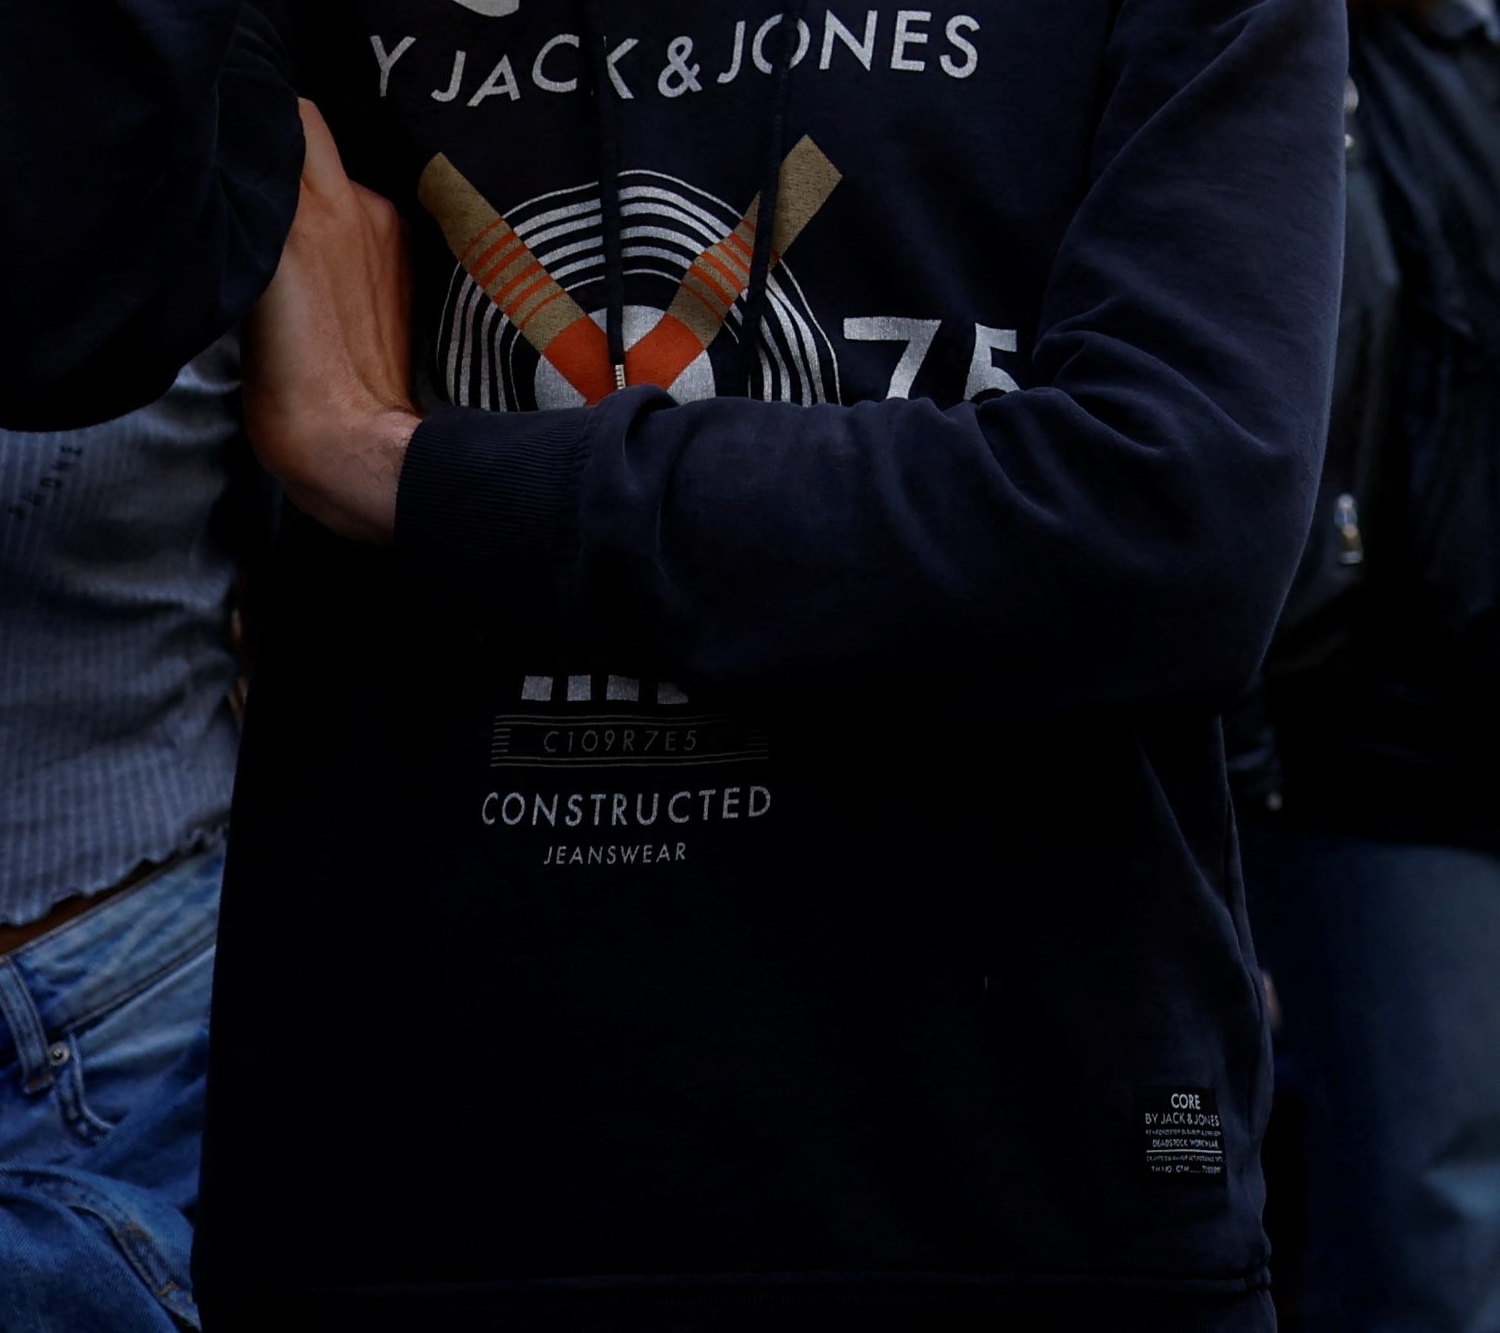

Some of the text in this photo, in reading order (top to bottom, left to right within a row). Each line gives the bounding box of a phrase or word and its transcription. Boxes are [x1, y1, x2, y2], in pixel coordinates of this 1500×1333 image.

[431, 33, 639, 108] JACK
[656, 33, 704, 99] &
[716, 8, 982, 85] JONES
[481, 785, 772, 827] CONSTRUCTED
[543, 841, 687, 866] JEANSWEAR
[1171, 1093, 1201, 1110] CORE
[1145, 1113, 1159, 1125] BY
[1160, 1112, 1186, 1125] JACK
